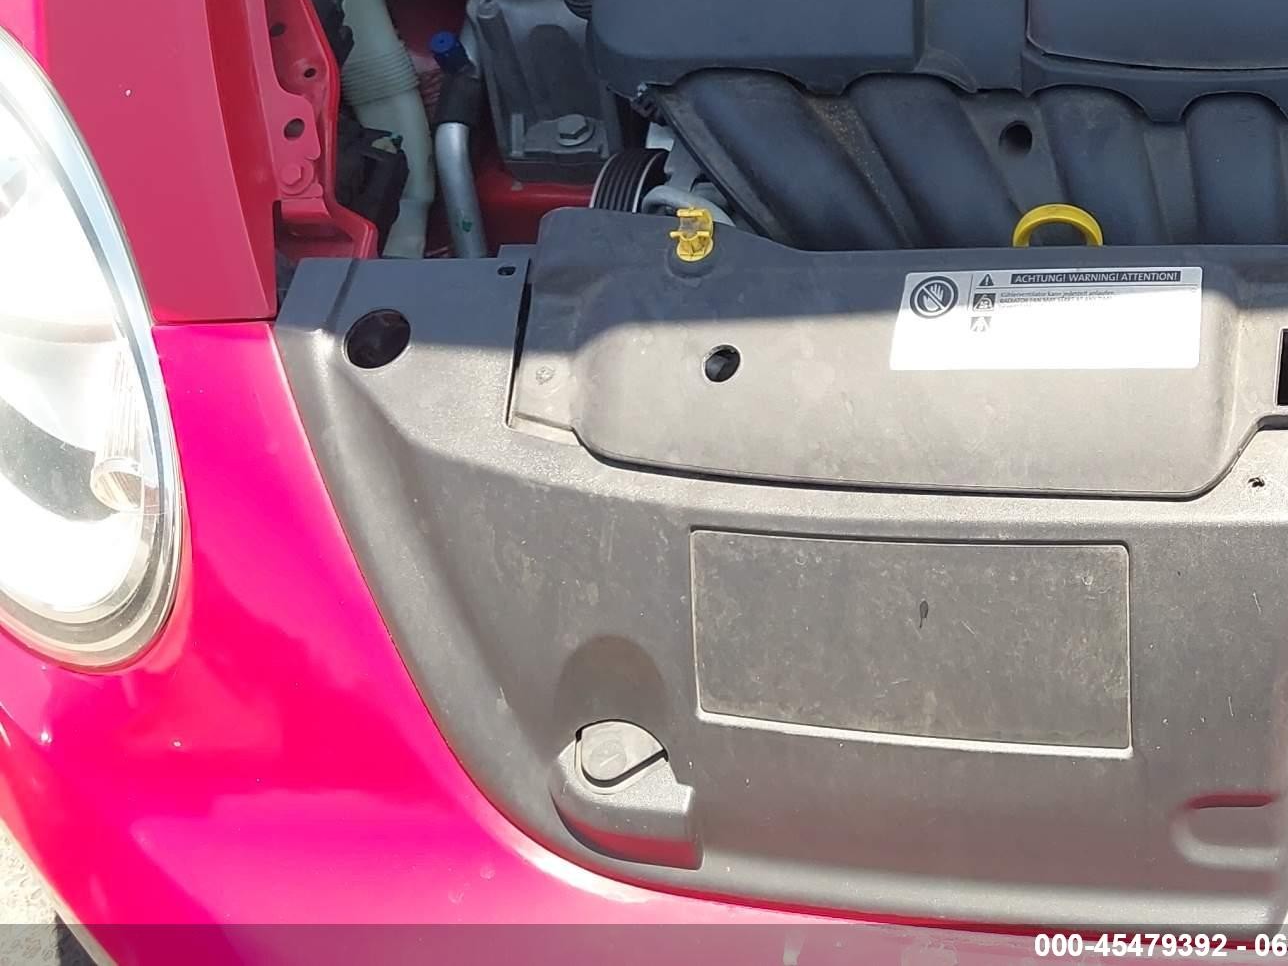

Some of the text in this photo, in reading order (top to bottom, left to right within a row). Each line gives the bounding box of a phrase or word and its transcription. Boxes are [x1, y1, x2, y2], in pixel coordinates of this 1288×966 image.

[1015, 272, 1177, 283] ACHTUNG! WARNING! ATTENTION!
